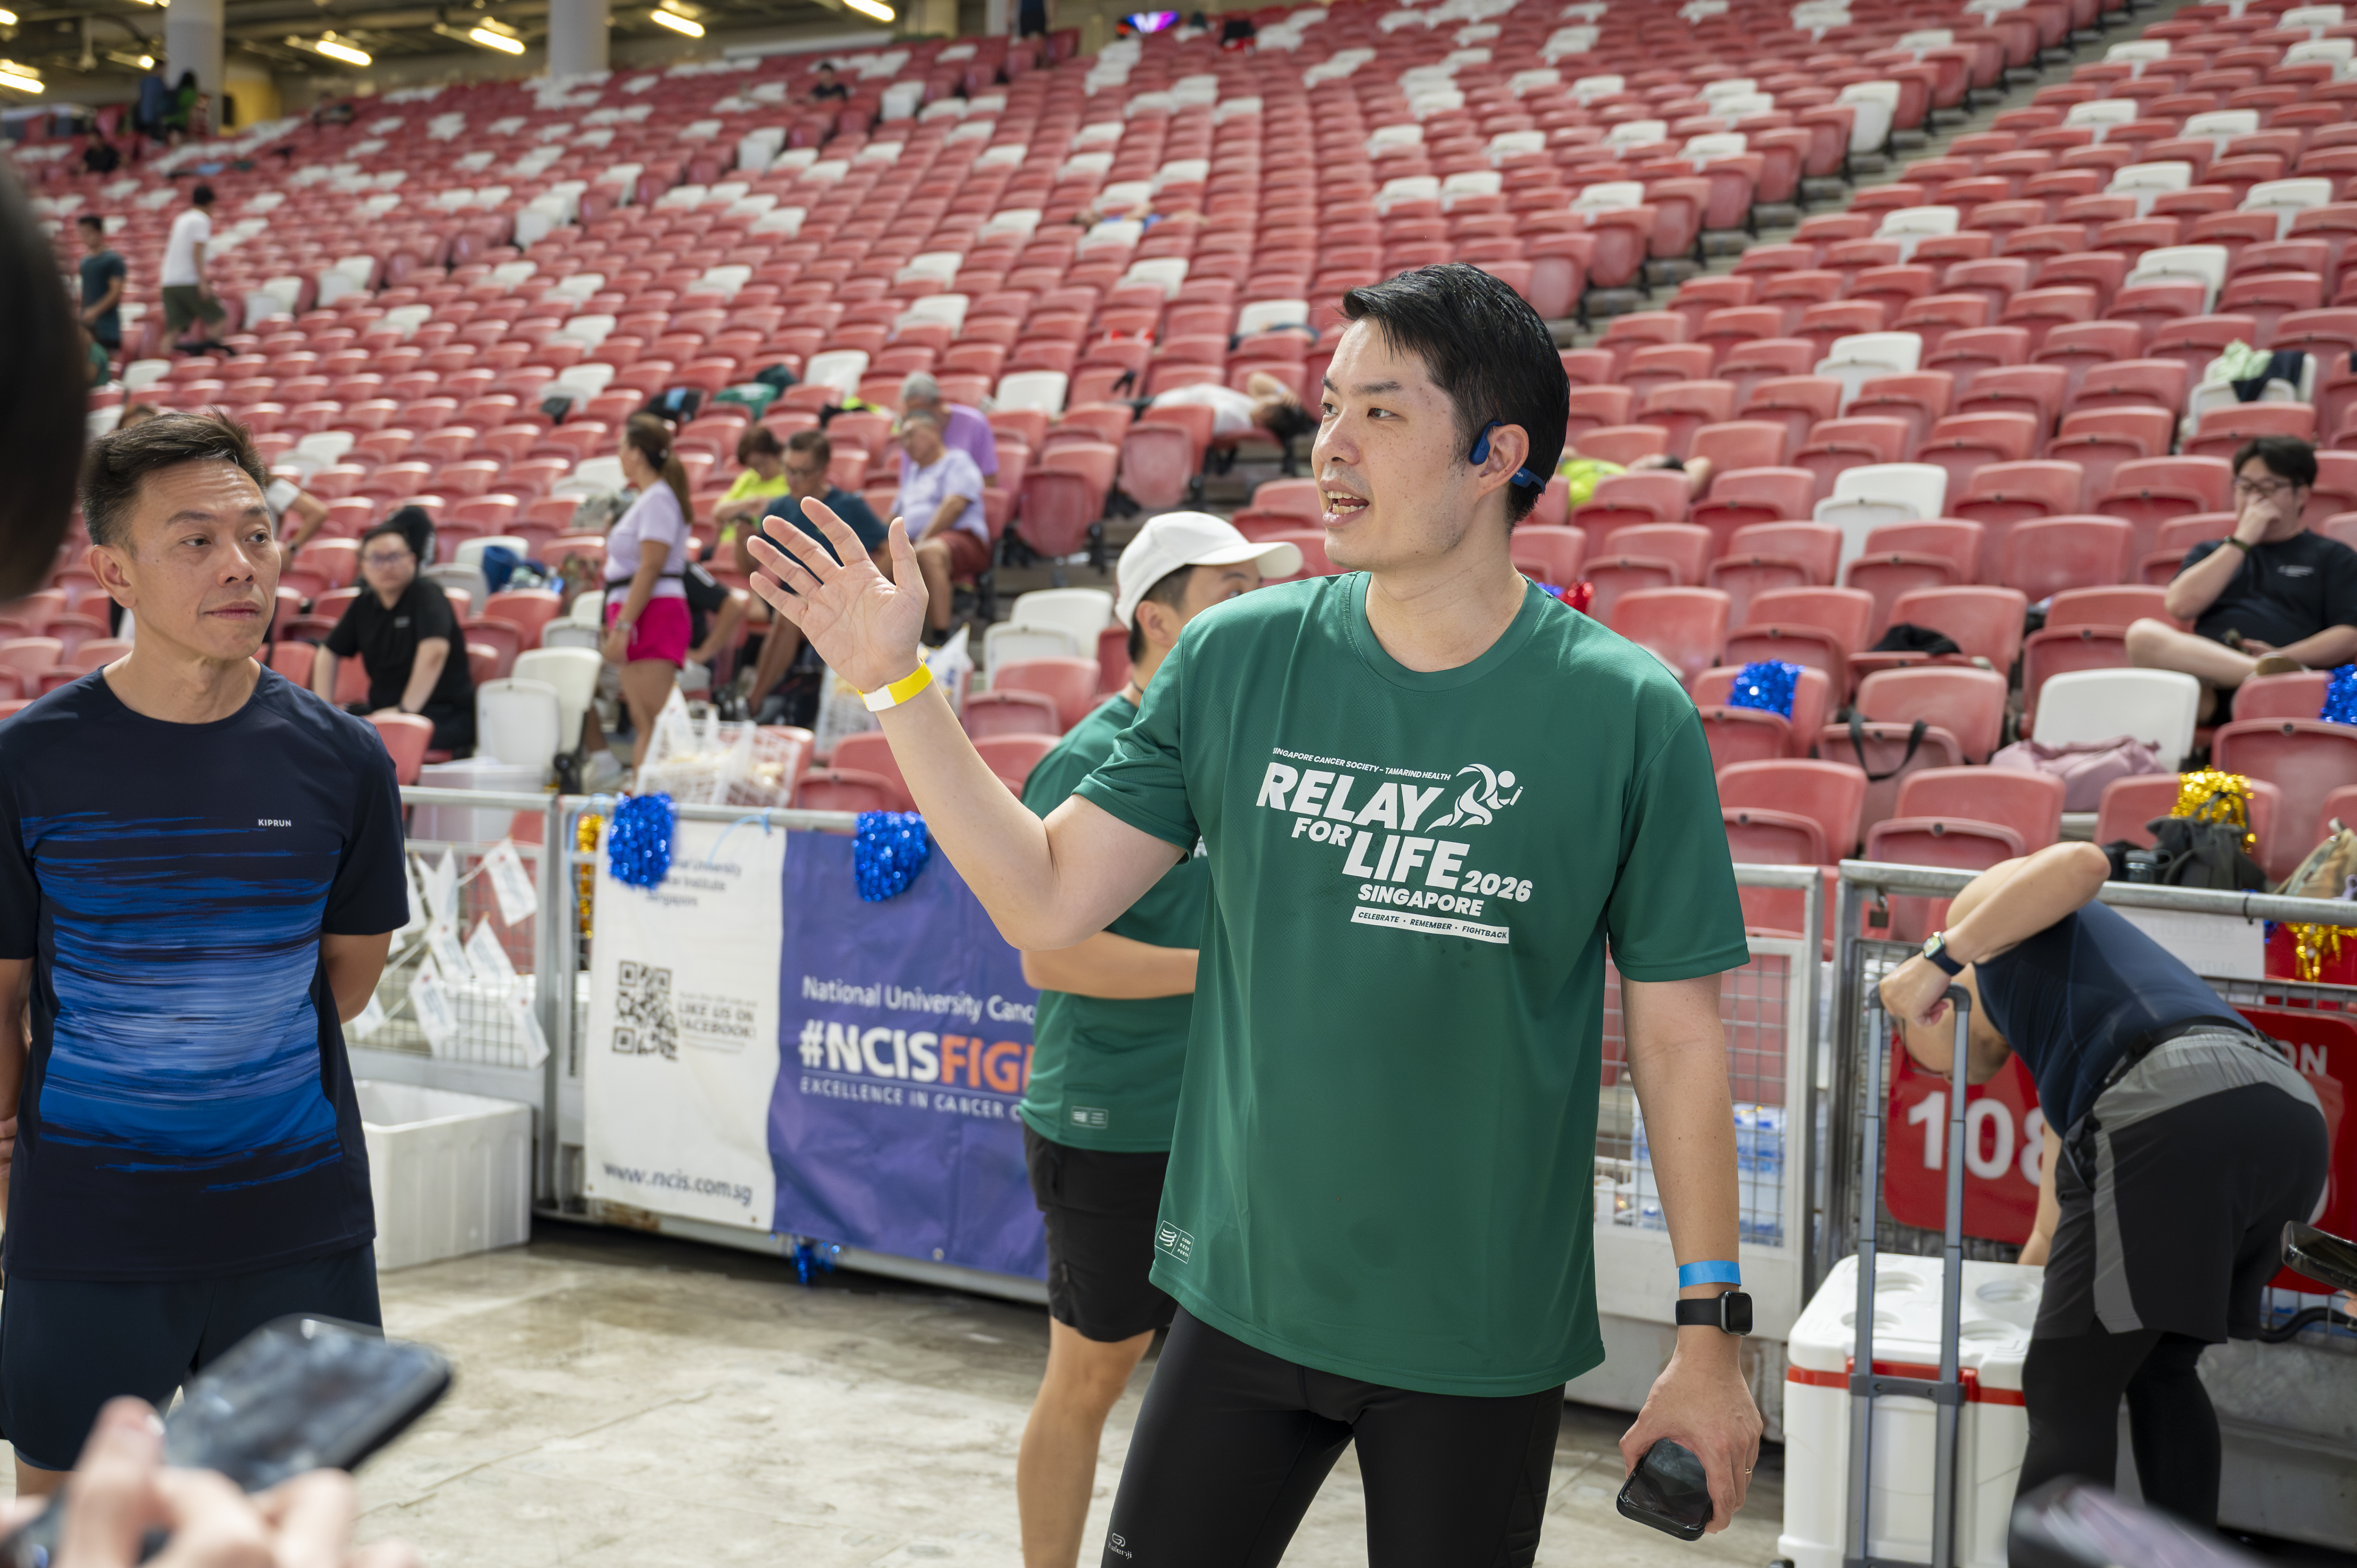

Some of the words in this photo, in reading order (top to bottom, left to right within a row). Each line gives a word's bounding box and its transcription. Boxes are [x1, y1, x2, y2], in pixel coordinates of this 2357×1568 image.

[1272, 747, 1314, 762] SINGAPORE
[1313, 756, 1345, 766] CANCER
[1345, 760, 1379, 772] SOCIETY
[1385, 767, 1422, 778] TAMARIND
[1422, 771, 1451, 781] HEALTH
[1256, 762, 1445, 831] RELAY
[258, 819, 292, 827] KIPRUN
[1291, 817, 1352, 847] FOR
[1342, 831, 1471, 890] LIFE
[1461, 870, 1533, 902] 2026
[1358, 884, 1484, 916] SINGAPORE
[1358, 912, 1400, 923] CELEBRATE
[1410, 919, 1452, 930] REMEMBER
[1462, 926, 1507, 938] FIGHTBACK
[802, 975, 882, 1008] National
[885, 985, 982, 1024] University
[800, 1076, 903, 1106] EXCELLENCE
[908, 1090, 929, 1109] IN
[934, 1093, 1004, 1118] CANCER
[1108, 1542, 1132, 1559] Kalenji
